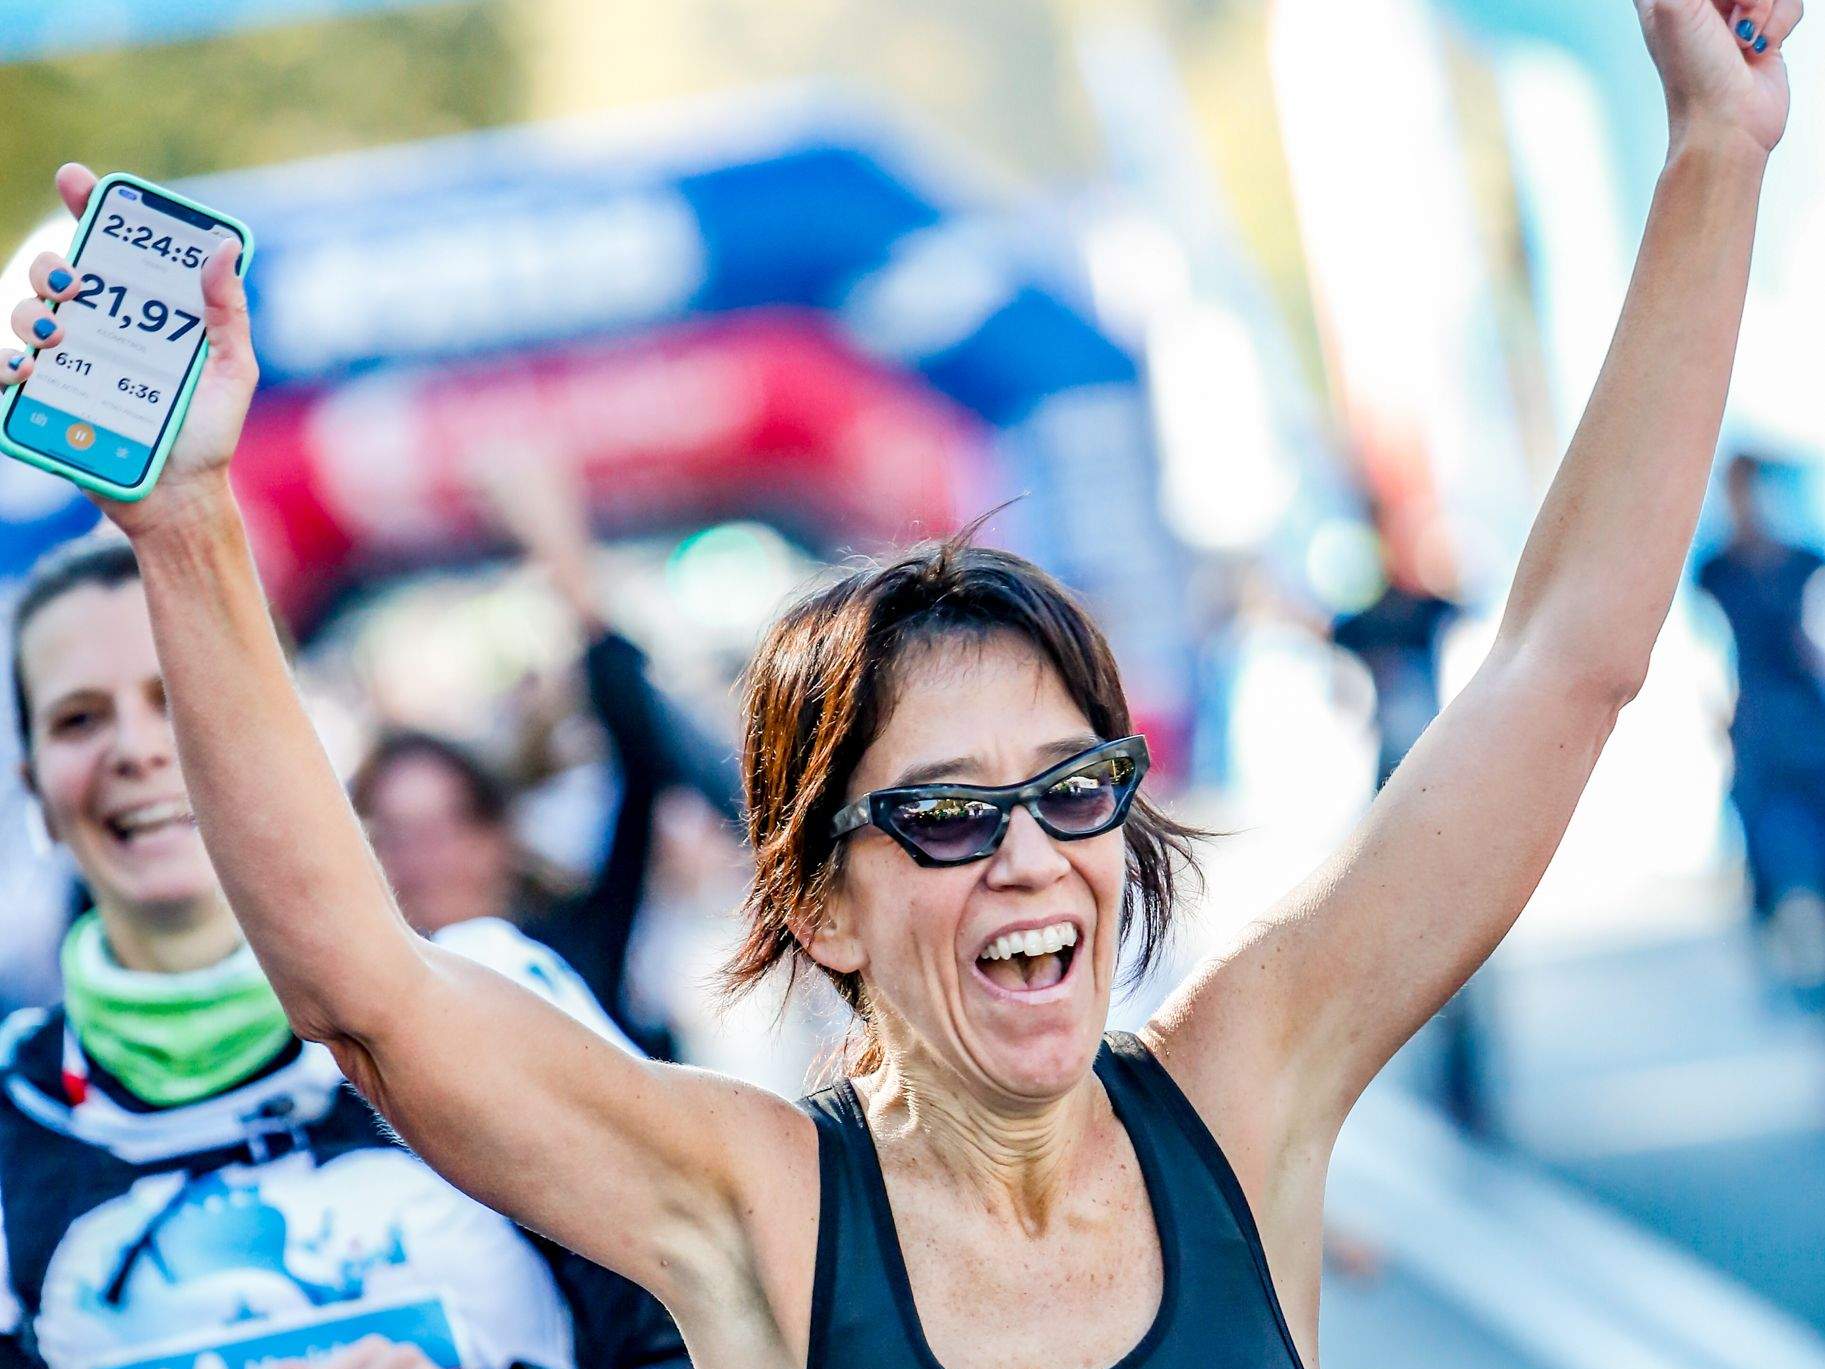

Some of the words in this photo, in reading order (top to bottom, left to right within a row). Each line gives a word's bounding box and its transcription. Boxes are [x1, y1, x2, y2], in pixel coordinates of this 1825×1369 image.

[103, 214, 209, 269] 2:24:5
[73, 273, 201, 342] 21,97
[55, 351, 93, 376] 6:11
[117, 377, 161, 404] 6:36
